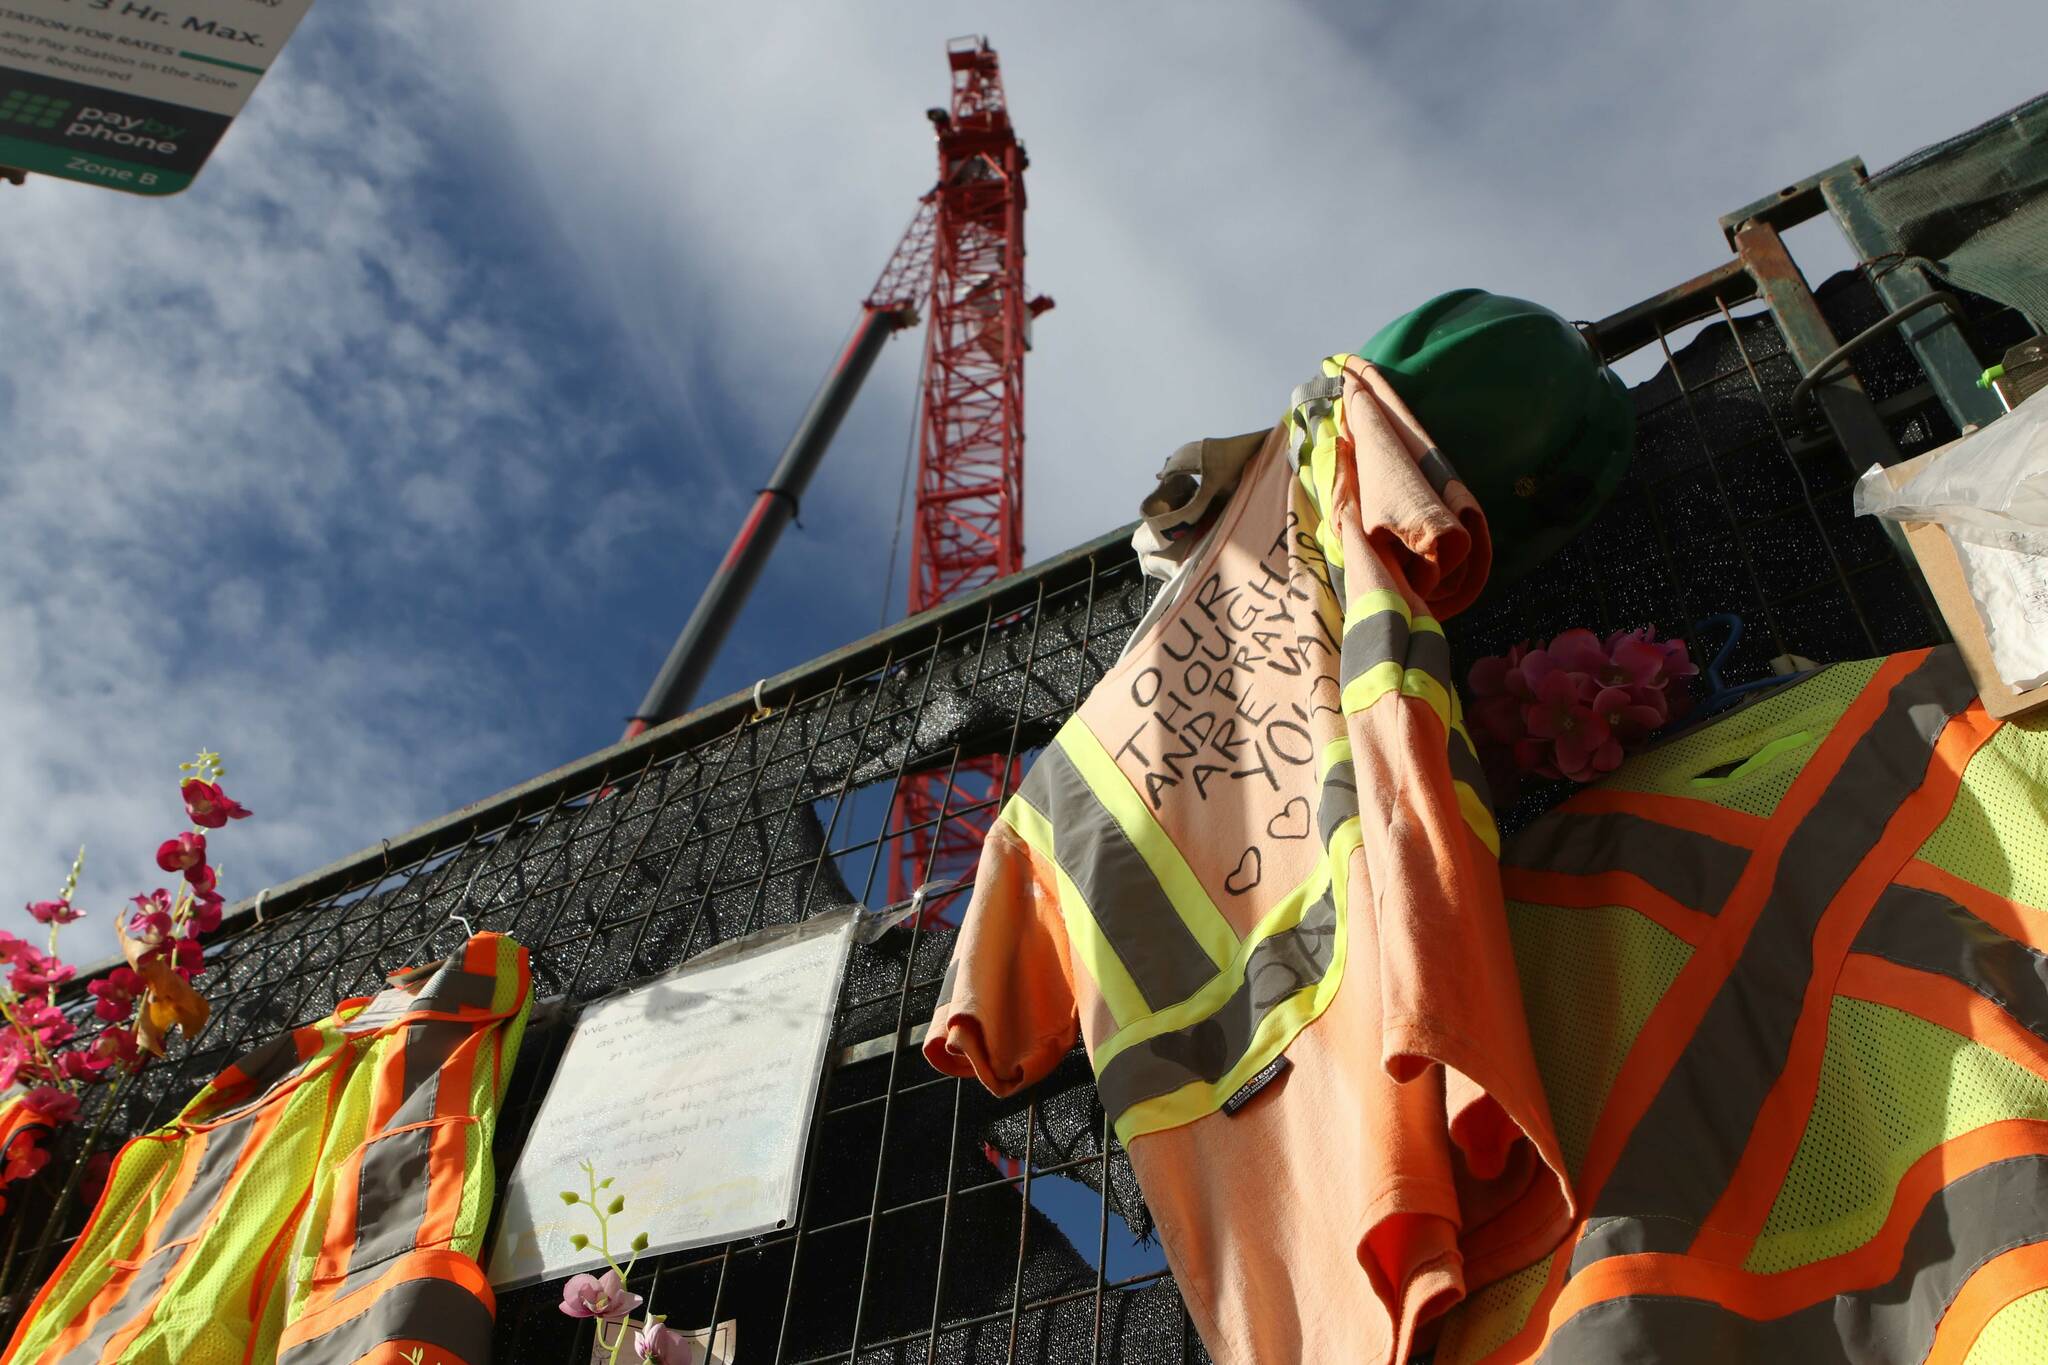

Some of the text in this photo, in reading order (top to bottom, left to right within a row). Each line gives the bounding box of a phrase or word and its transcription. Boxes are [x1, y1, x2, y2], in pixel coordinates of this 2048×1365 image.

[74, 26, 113, 42] FOR
[116, 36, 174, 56] RATES
[121, 2, 169, 25] Hr.
[181, 15, 265, 47] Max.
[45, 55, 132, 82] Required
[73, 44, 136, 67] Station
[140, 58, 157, 71] in
[160, 64, 191, 79] the
[192, 72, 238, 90] Zone
[65, 121, 178, 154] phone
[65, 156, 159, 187] Zone B
[1131, 572, 1239, 707] OUR
[1145, 711, 1217, 810] AND
[1193, 683, 1278, 800] ARE
